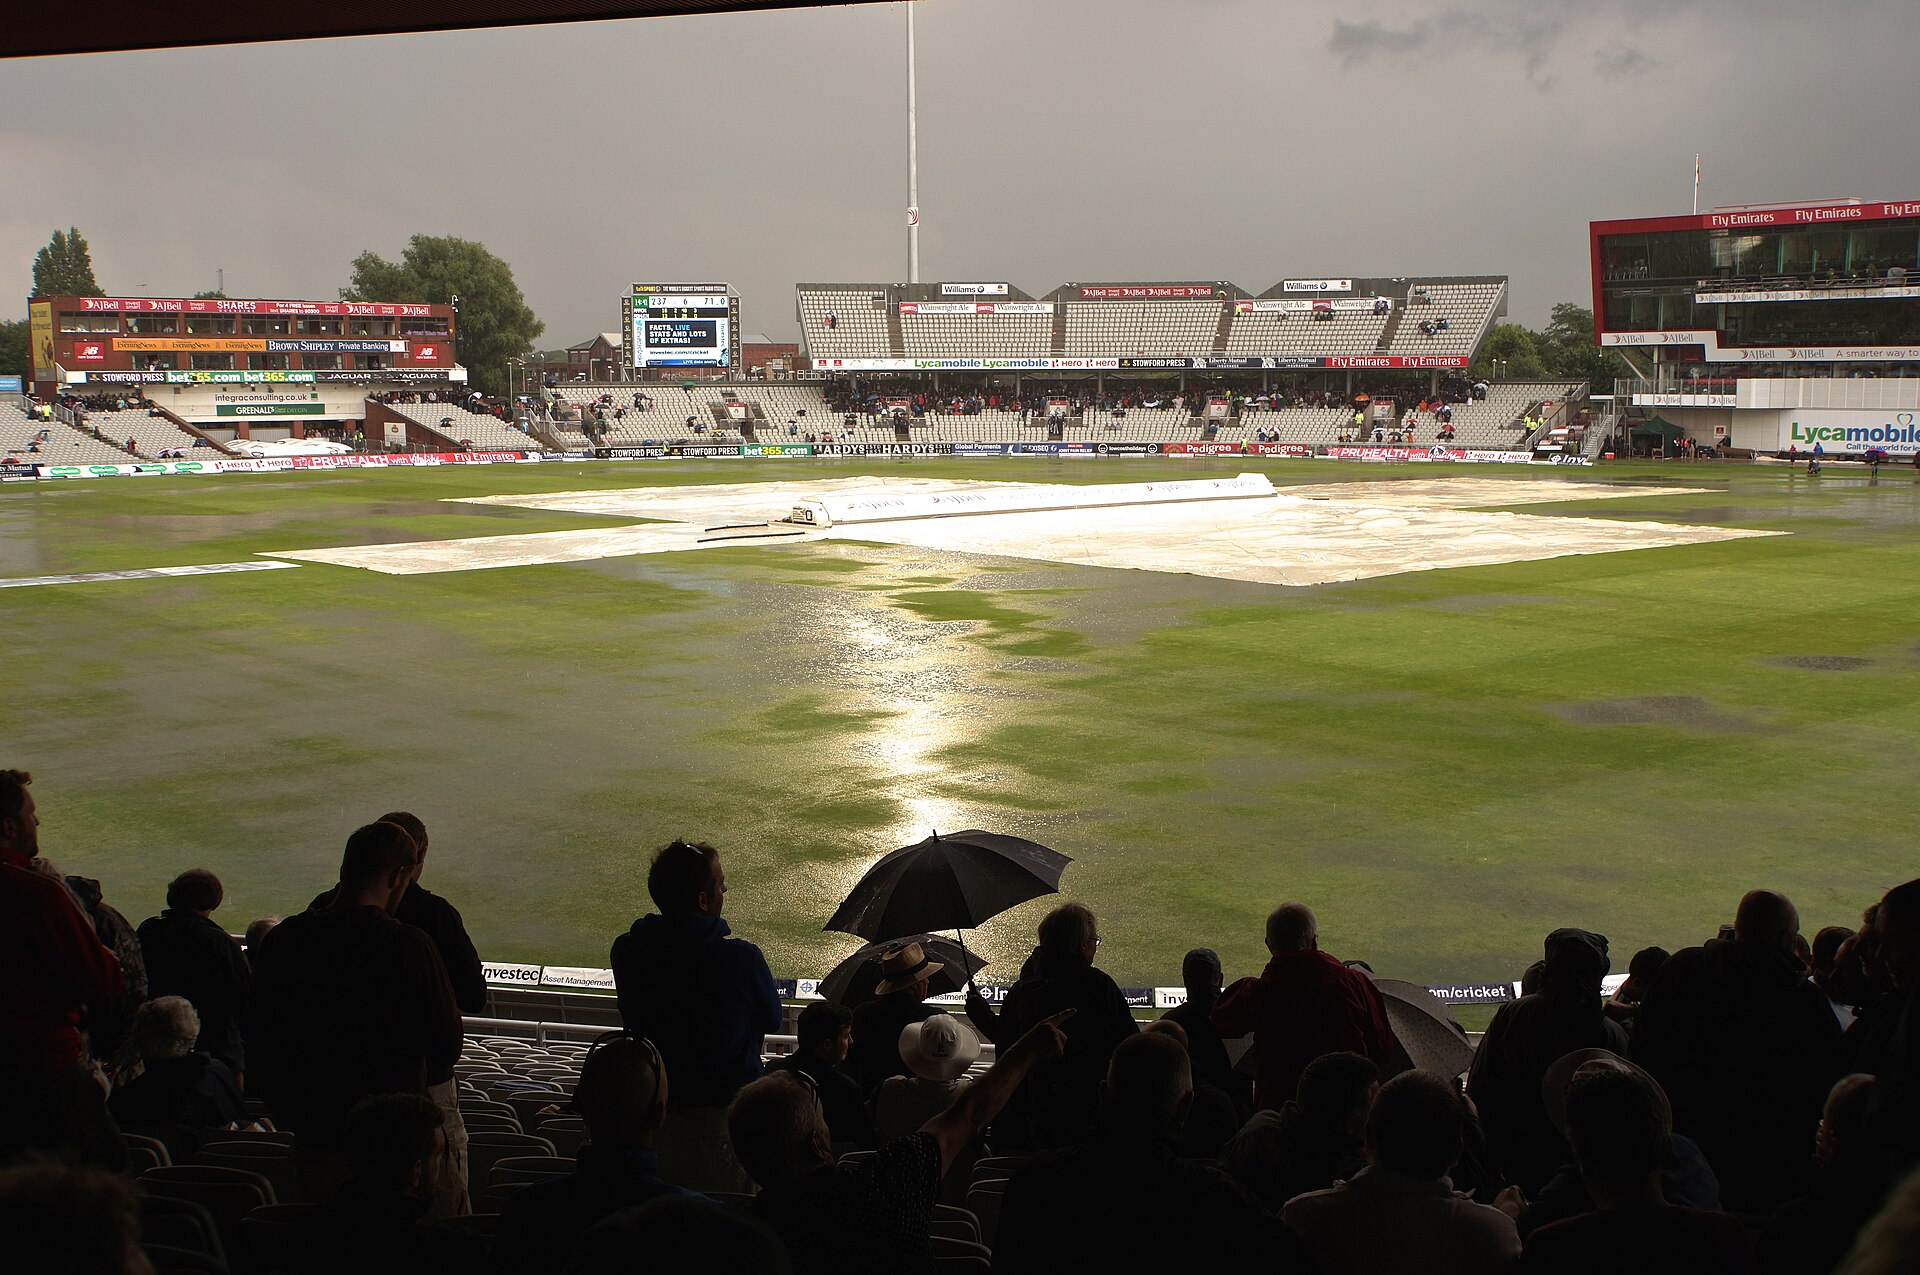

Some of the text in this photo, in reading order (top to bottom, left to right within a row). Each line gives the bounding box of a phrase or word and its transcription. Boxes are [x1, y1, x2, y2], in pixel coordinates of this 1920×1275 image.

[1795, 208, 1861, 221] Fly Emirates
[1884, 204, 1902, 216] Fly
[1712, 214, 1774, 226] Fly Emirates
[93, 300, 119, 311] AJBell
[157, 301, 182, 311] AJBell
[217, 301, 256, 310] SHARES
[919, 304, 957, 312] Wainwright
[997, 304, 1034, 312] Wainwright
[1255, 301, 1294, 309] Wainwright
[1334, 300, 1372, 309] Wainwright
[354, 306, 375, 314] AJBell
[408, 307, 429, 316] AJBell
[1620, 335, 1645, 344] AJBell
[1668, 334, 1693, 343] AJBell
[269, 340, 388, 351] BROWN SHIPLEY Private Banking
[1749, 350, 1775, 360] AJBell
[1797, 350, 1824, 359] AJBell
[914, 359, 980, 368] Lycamobile
[983, 358, 1049, 368] Lycamobile
[1331, 357, 1390, 368] Fly Emirates
[1402, 357, 1461, 367] Fly Emirates
[102, 373, 164, 382] STOWFORD PRESS
[243, 372, 313, 382] bet365.com
[215, 394, 307, 403] integraconsulting.co.uk
[610, 449, 644, 457] STOWFORD
[683, 447, 738, 456] STOWFORD PRESS
[744, 446, 807, 456] bet365.com
[882, 444, 934, 454] HARDYS
[1186, 444, 1231, 454] Pedigree
[1258, 444, 1303, 455] Pedigree
[1340, 448, 1409, 458] PRUHEALTH
[312, 455, 388, 466] PRUHEALTH
[454, 452, 515, 463] Fly Emirates
[1508, 453, 1529, 461] Hero
[482, 967, 539, 981] nvestec
[542, 974, 613, 987] Asset Management
[1163, 994, 1186, 1004] inv
